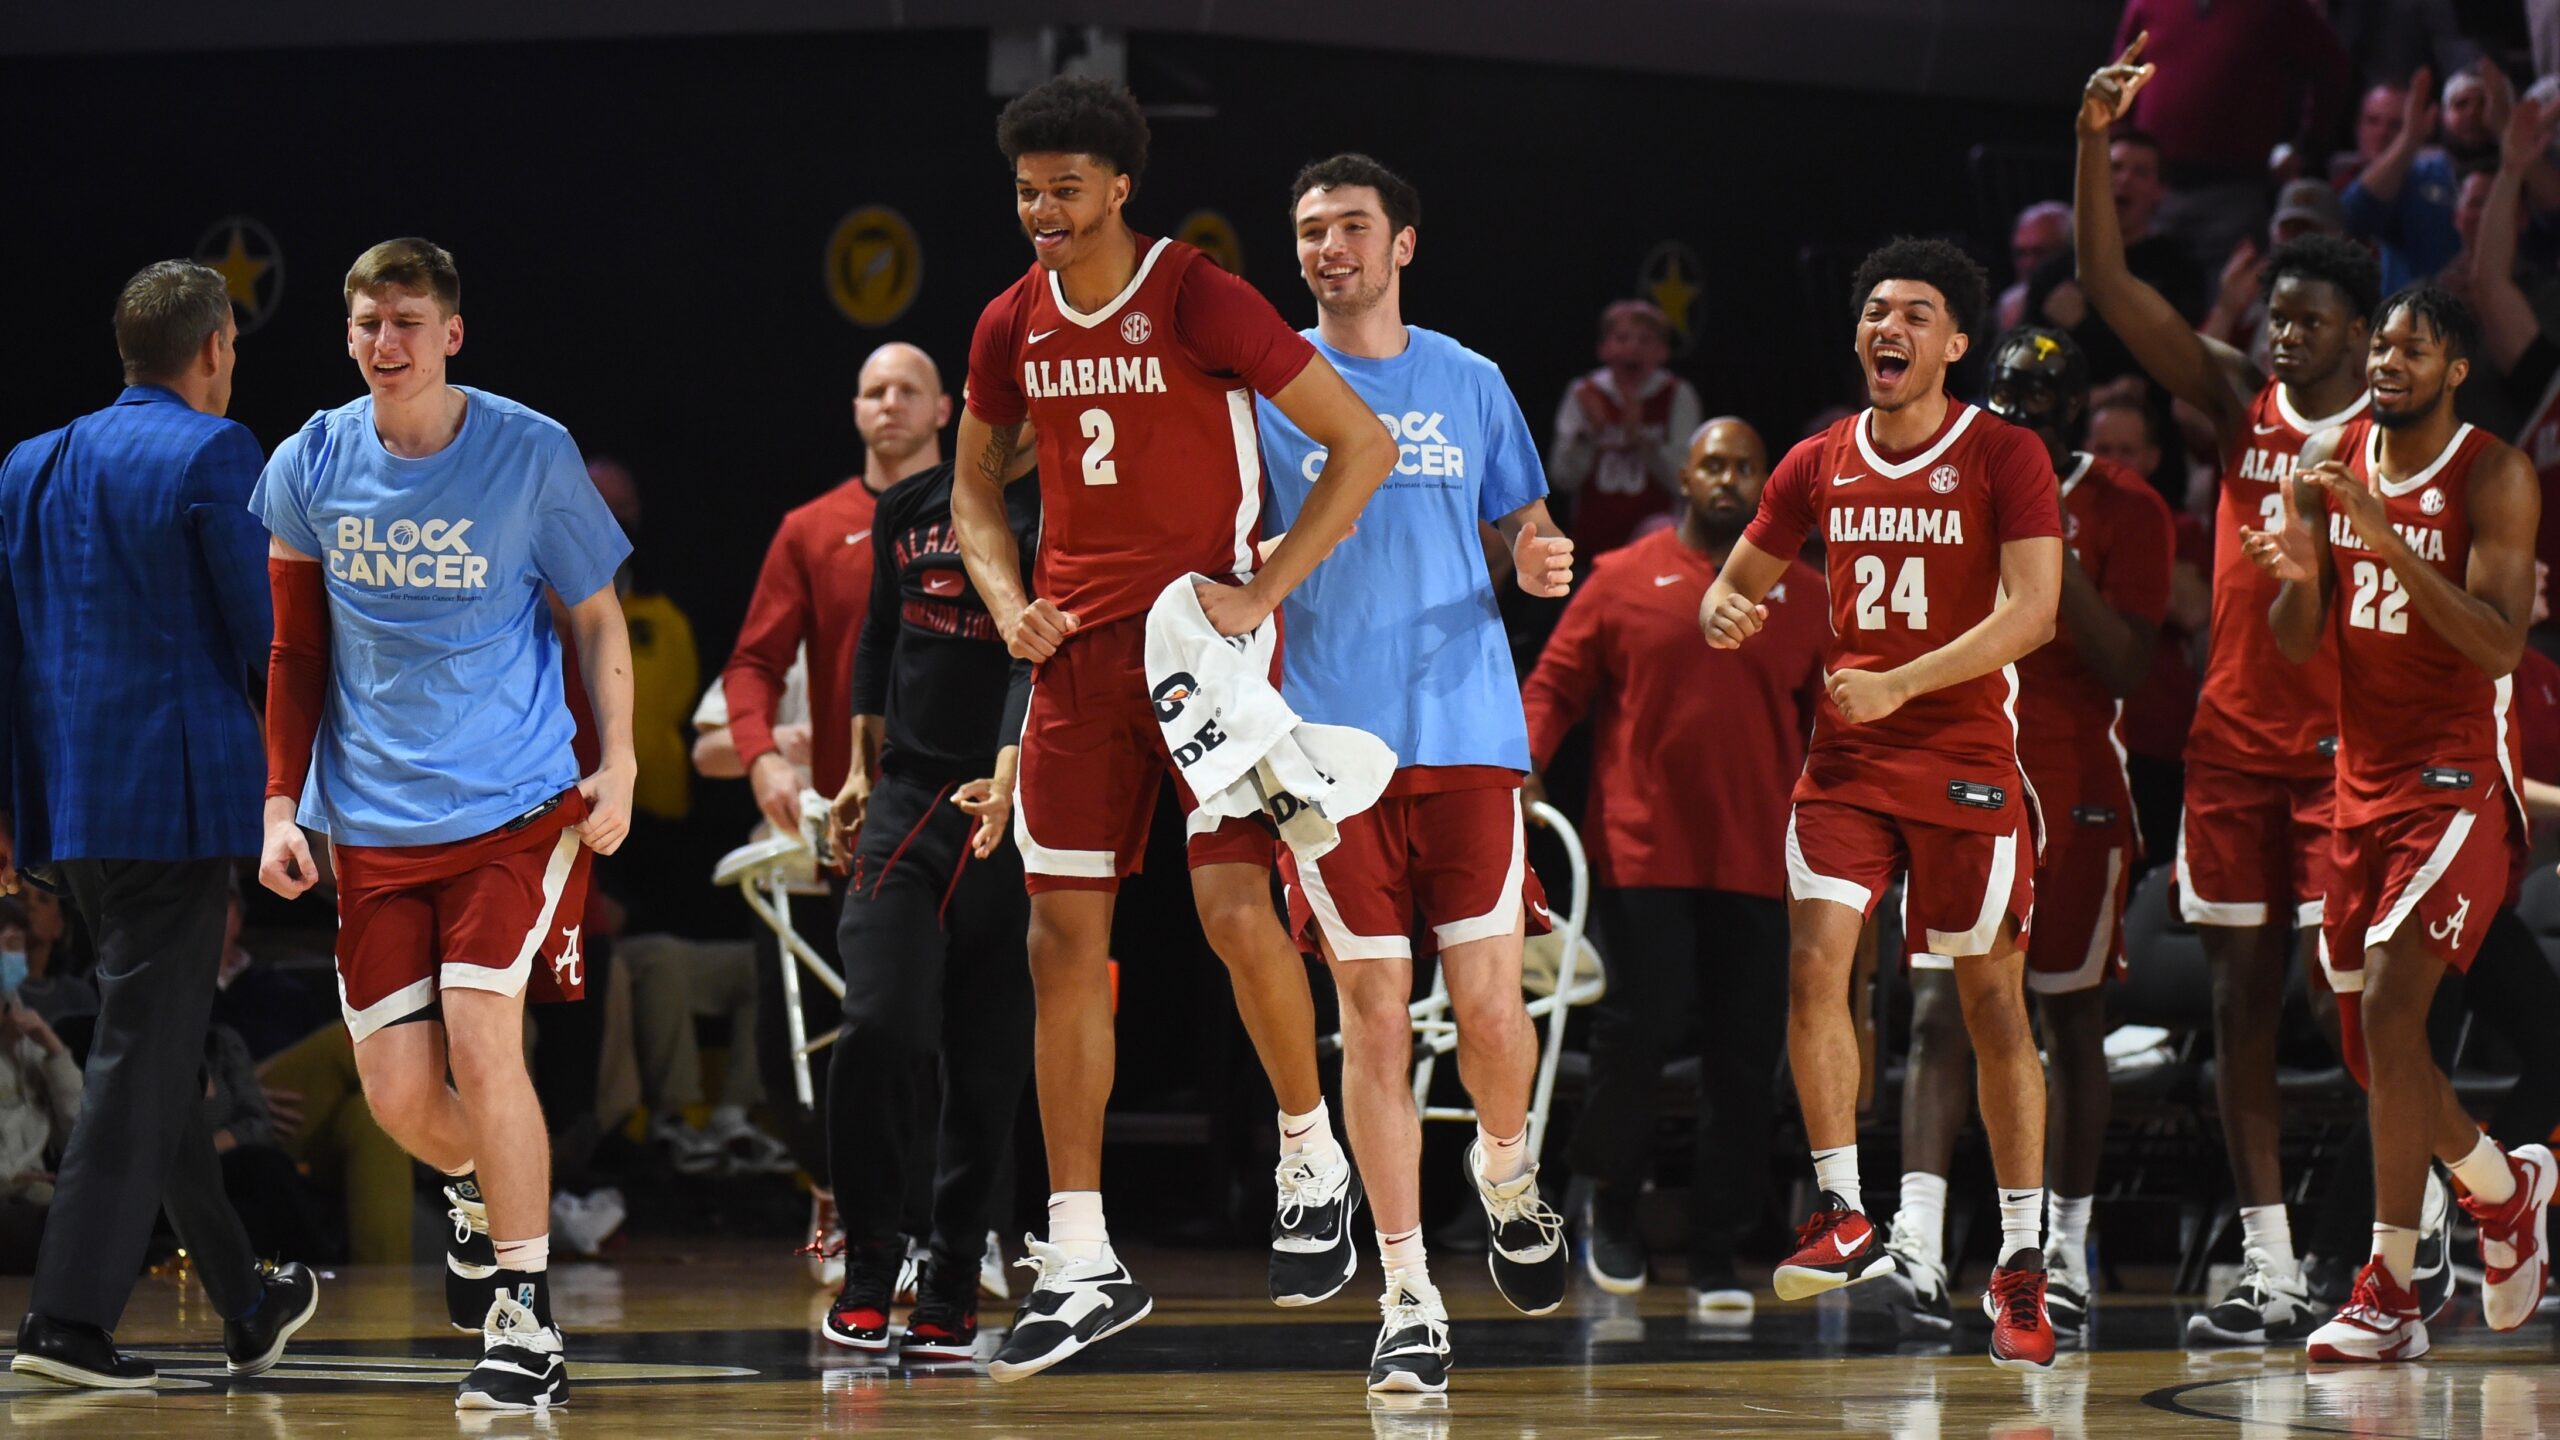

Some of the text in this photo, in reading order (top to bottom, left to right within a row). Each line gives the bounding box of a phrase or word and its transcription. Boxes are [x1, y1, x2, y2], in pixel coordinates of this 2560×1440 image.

[1123, 314, 1150, 342] SEC
[1024, 356, 1168, 398] ALABAMA
[1079, 408, 1118, 485] 2
[1376, 411, 1449, 445] OCK
[1302, 443, 1464, 482] CCER
[1931, 466, 1957, 491] SEC
[2421, 490, 2444, 513] SEC
[338, 516, 475, 555] BLOCK
[1830, 507, 1963, 544] ALABAMA
[329, 550, 488, 588] CANCER
[1855, 555, 1928, 630] 24
[2350, 561, 2410, 634] 22
[1992, 792, 2002, 801] 42
